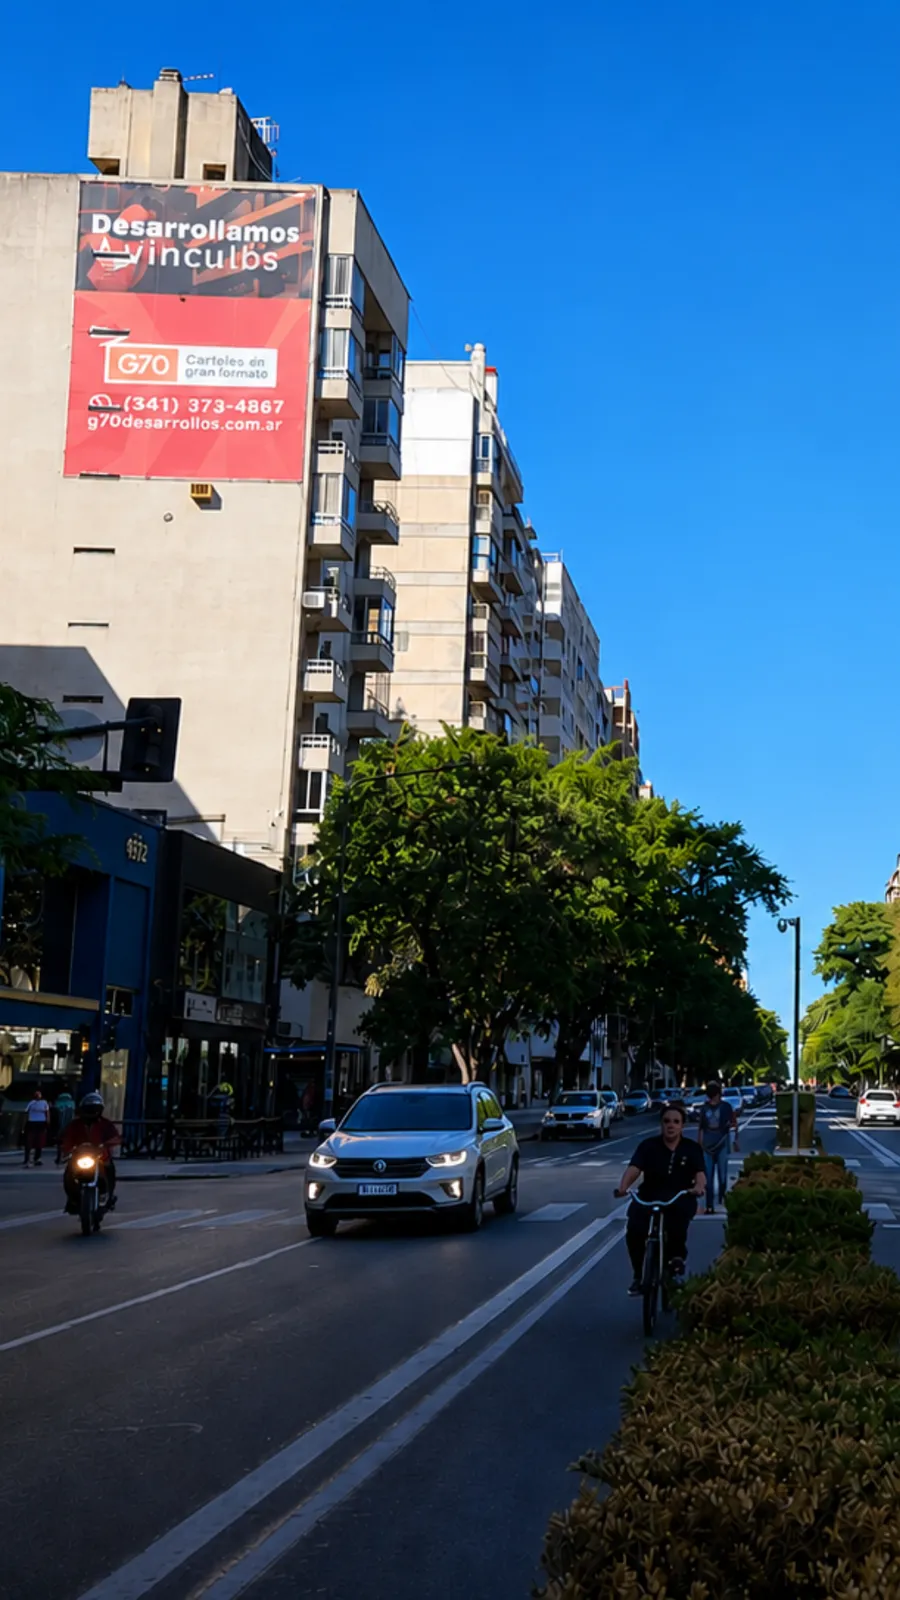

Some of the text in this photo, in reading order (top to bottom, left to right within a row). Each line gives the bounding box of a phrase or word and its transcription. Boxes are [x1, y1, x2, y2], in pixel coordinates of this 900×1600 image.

[92, 213, 299, 244] Desarrollamos
[117, 353, 170, 375] G70
[185, 366, 269, 379] gran formato
[123, 395, 284, 414] (341) 373-4867
[87, 413, 283, 431] g70desarrollos.com.ar
